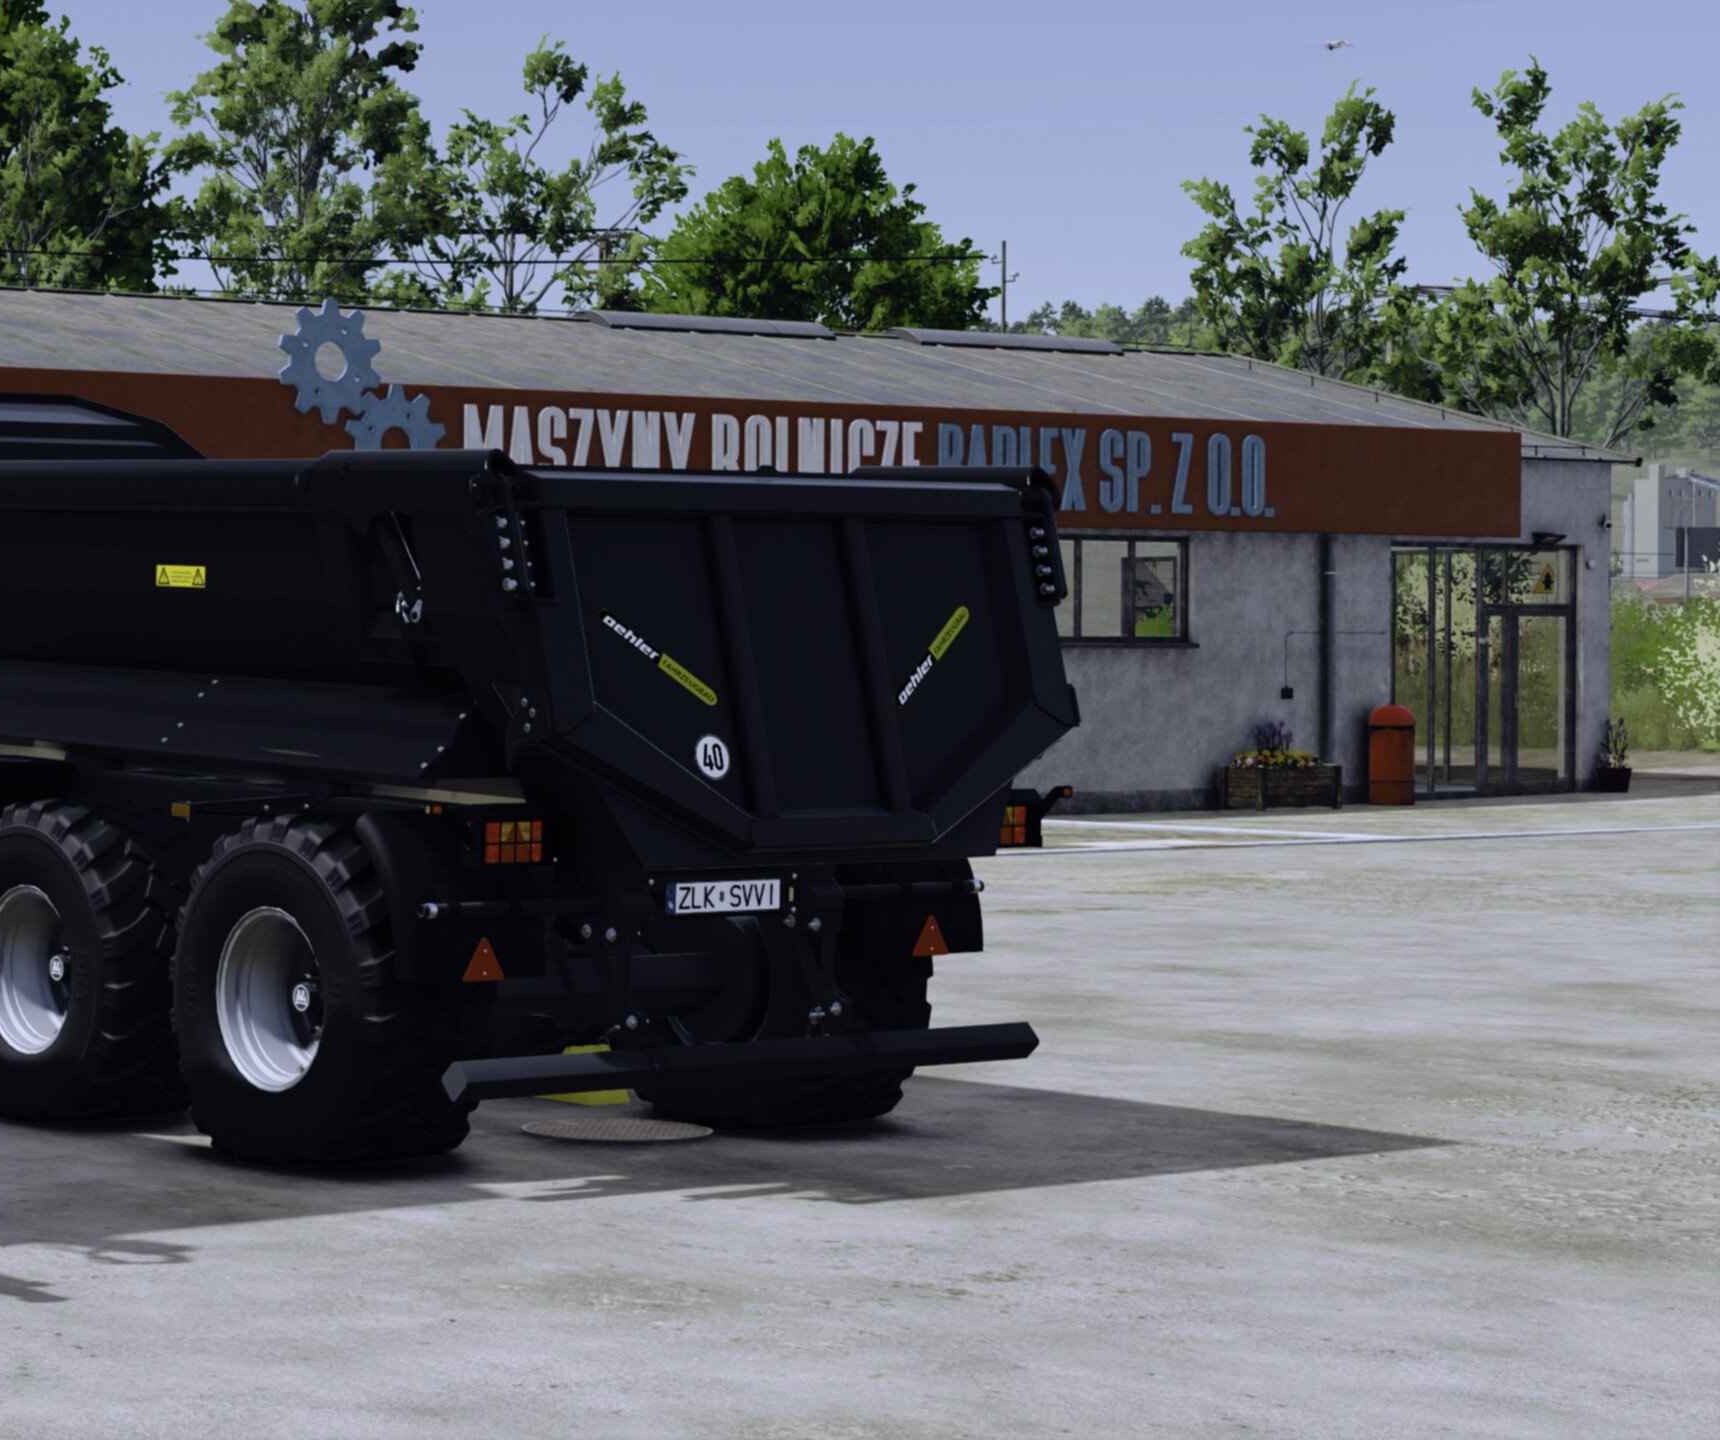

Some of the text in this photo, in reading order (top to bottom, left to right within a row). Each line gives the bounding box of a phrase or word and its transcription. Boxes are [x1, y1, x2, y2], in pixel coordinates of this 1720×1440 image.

[464, 403, 696, 470] MASZYNY
[711, 413, 923, 474] ROLNICZE
[1099, 428, 1162, 515] SP.
[1171, 432, 1194, 514] Z
[1207, 433, 1276, 518] O.O.
[602, 615, 660, 660] oehler
[898, 653, 933, 706] oehler
[703, 743, 724, 771] 40
[678, 885, 716, 910] ZLK
